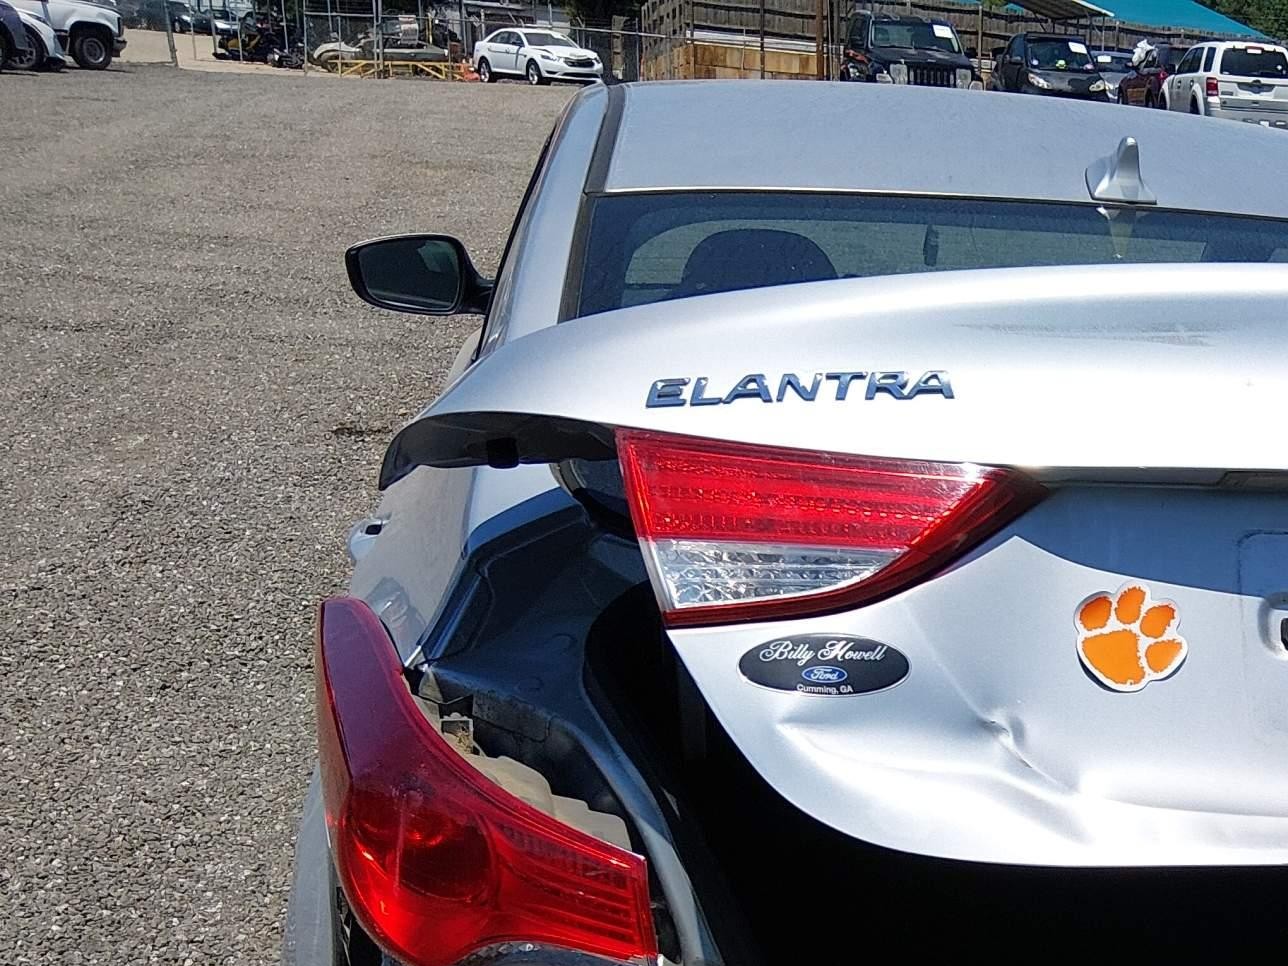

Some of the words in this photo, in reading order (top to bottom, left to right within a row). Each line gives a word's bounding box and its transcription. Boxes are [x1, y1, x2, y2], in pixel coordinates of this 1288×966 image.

[645, 369, 956, 409] ELANTRA
[759, 640, 816, 666] Billy
[817, 640, 888, 662] Howell
[809, 667, 840, 681] Ford
[796, 683, 839, 696] Cumming,
[840, 684, 854, 694] GA
